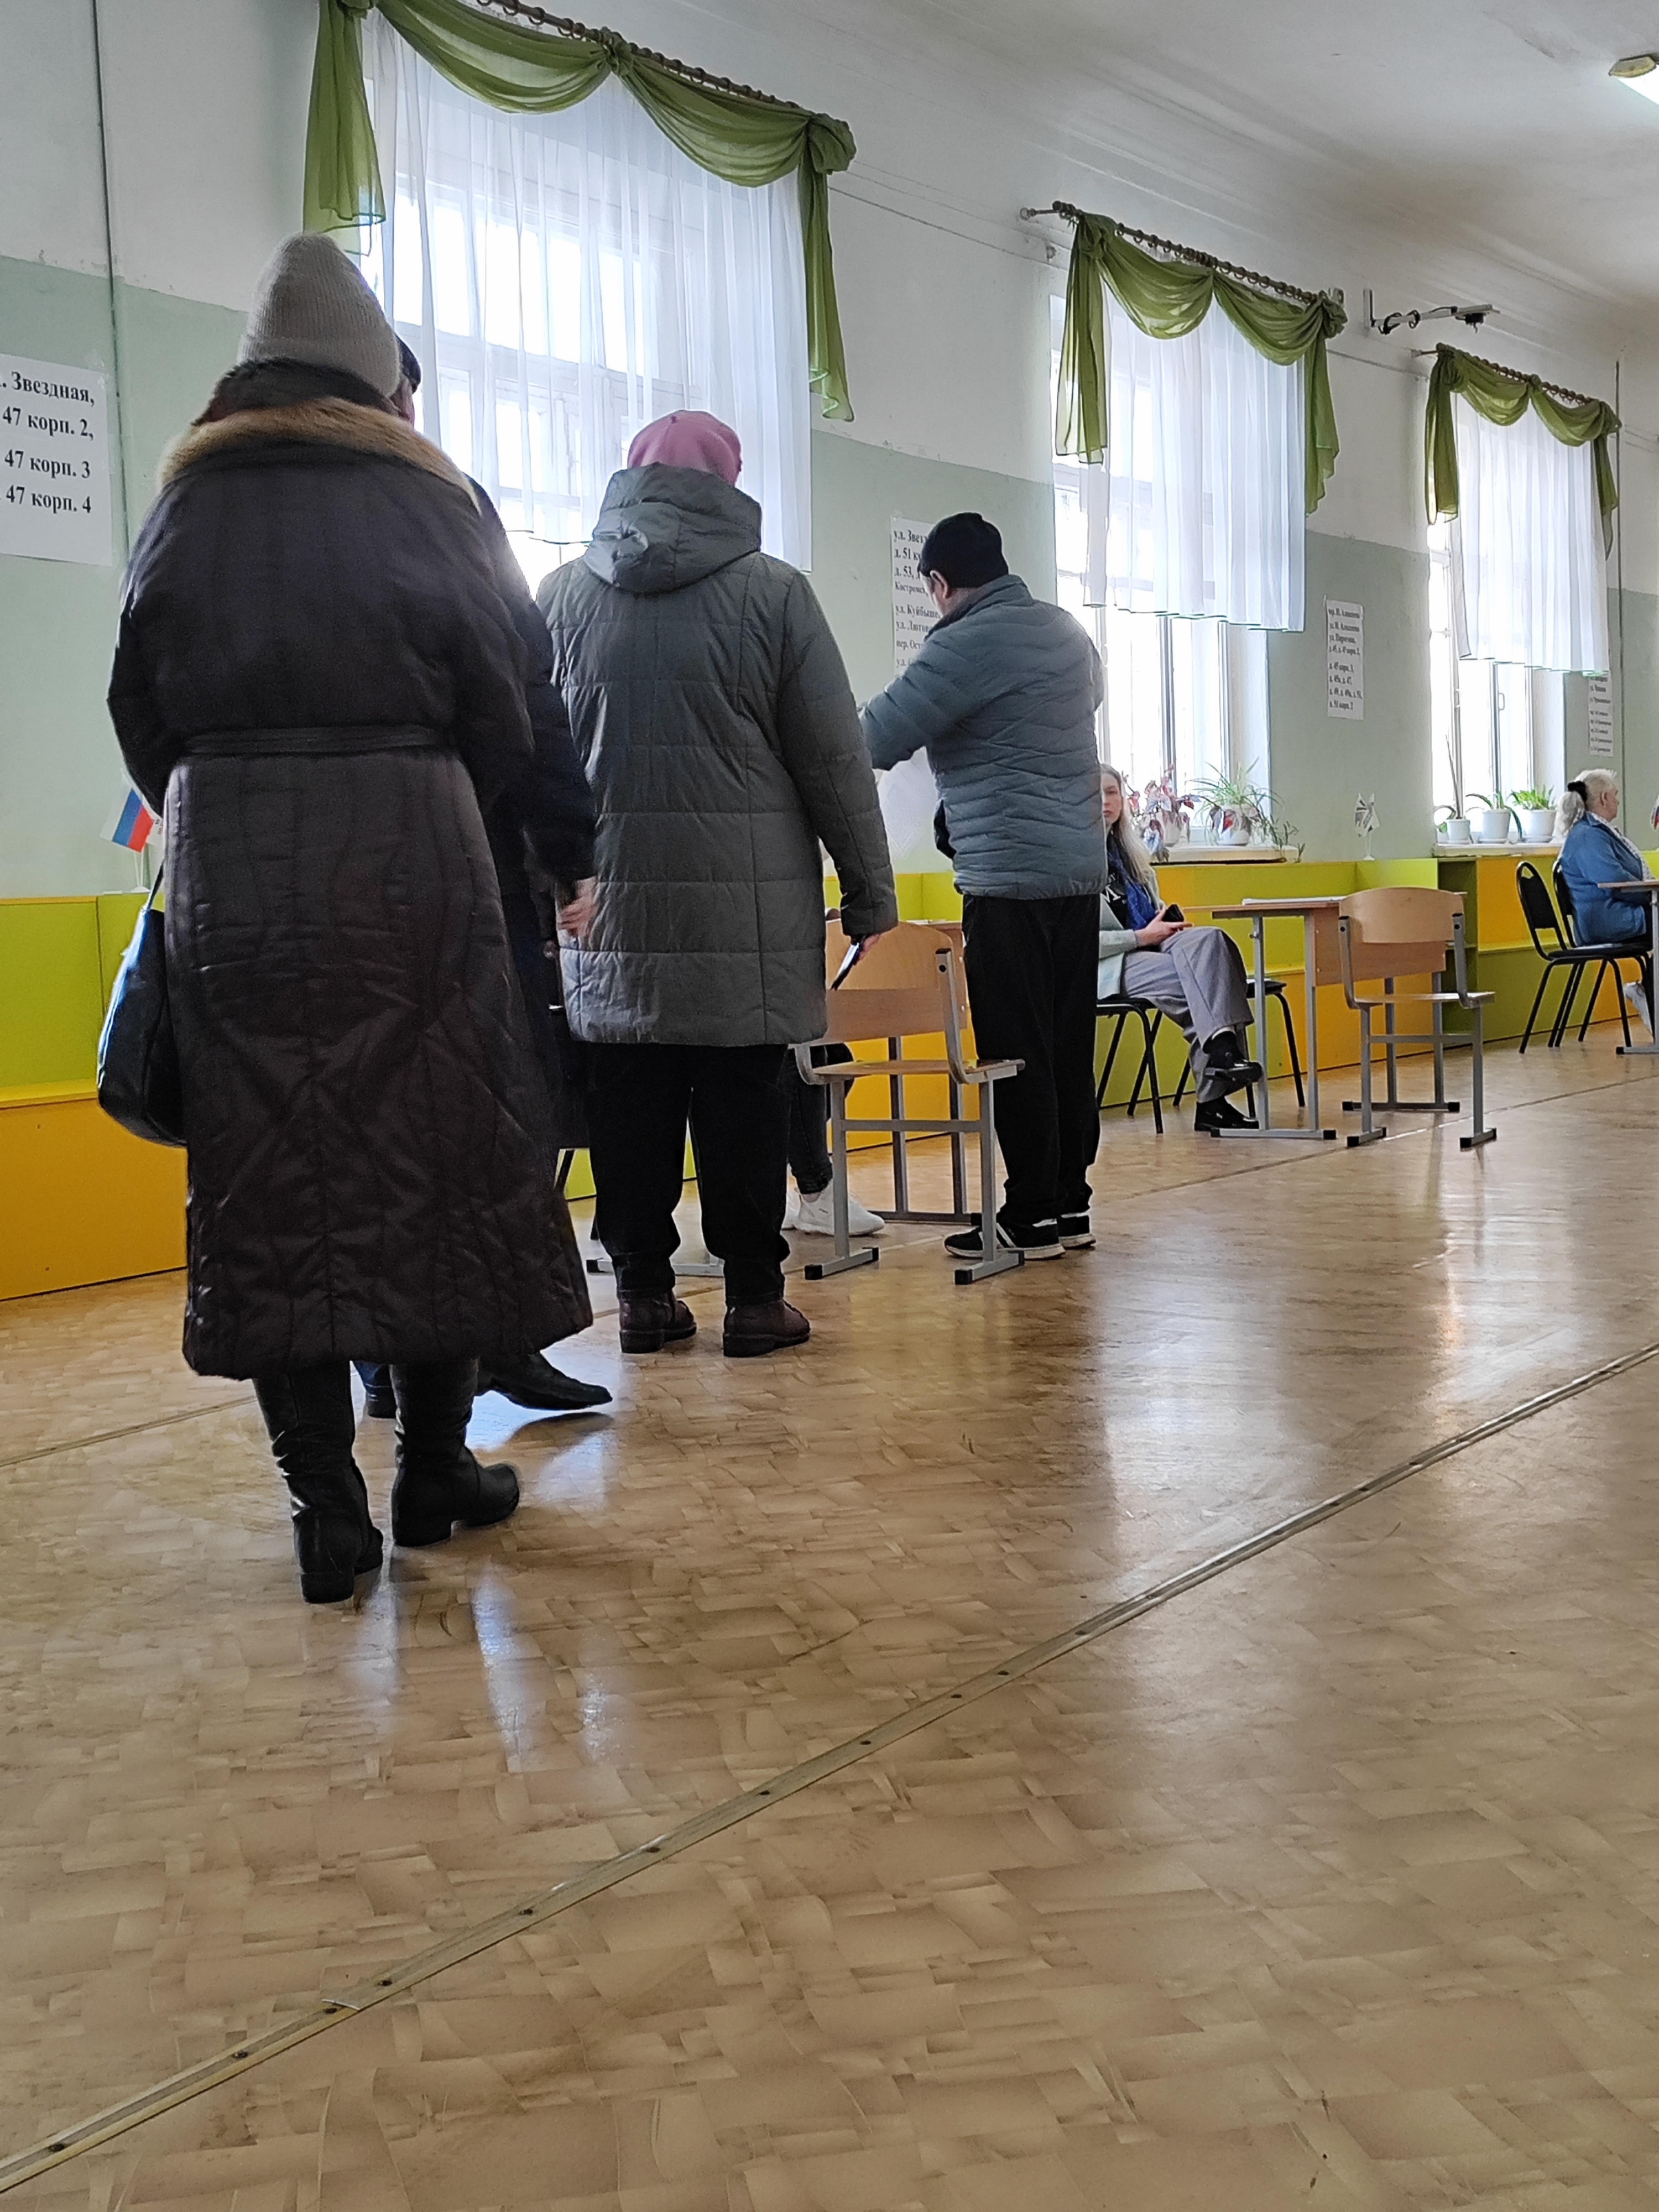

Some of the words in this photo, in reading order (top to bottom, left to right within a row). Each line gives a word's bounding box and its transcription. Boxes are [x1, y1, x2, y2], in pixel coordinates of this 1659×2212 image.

[11, 371, 95, 407] Звездная,
[2, 405, 21, 426] 47
[28, 414, 75, 437] корп.
[80, 419, 93, 441] 2,
[4, 448, 24, 468] 47
[30, 457, 77, 479] корп.
[81, 461, 91, 479] 3
[6, 484, 25, 504] 47
[31, 493, 77, 514] корп.
[82, 495, 91, 513] 4
[903, 547, 911, 560] 51
